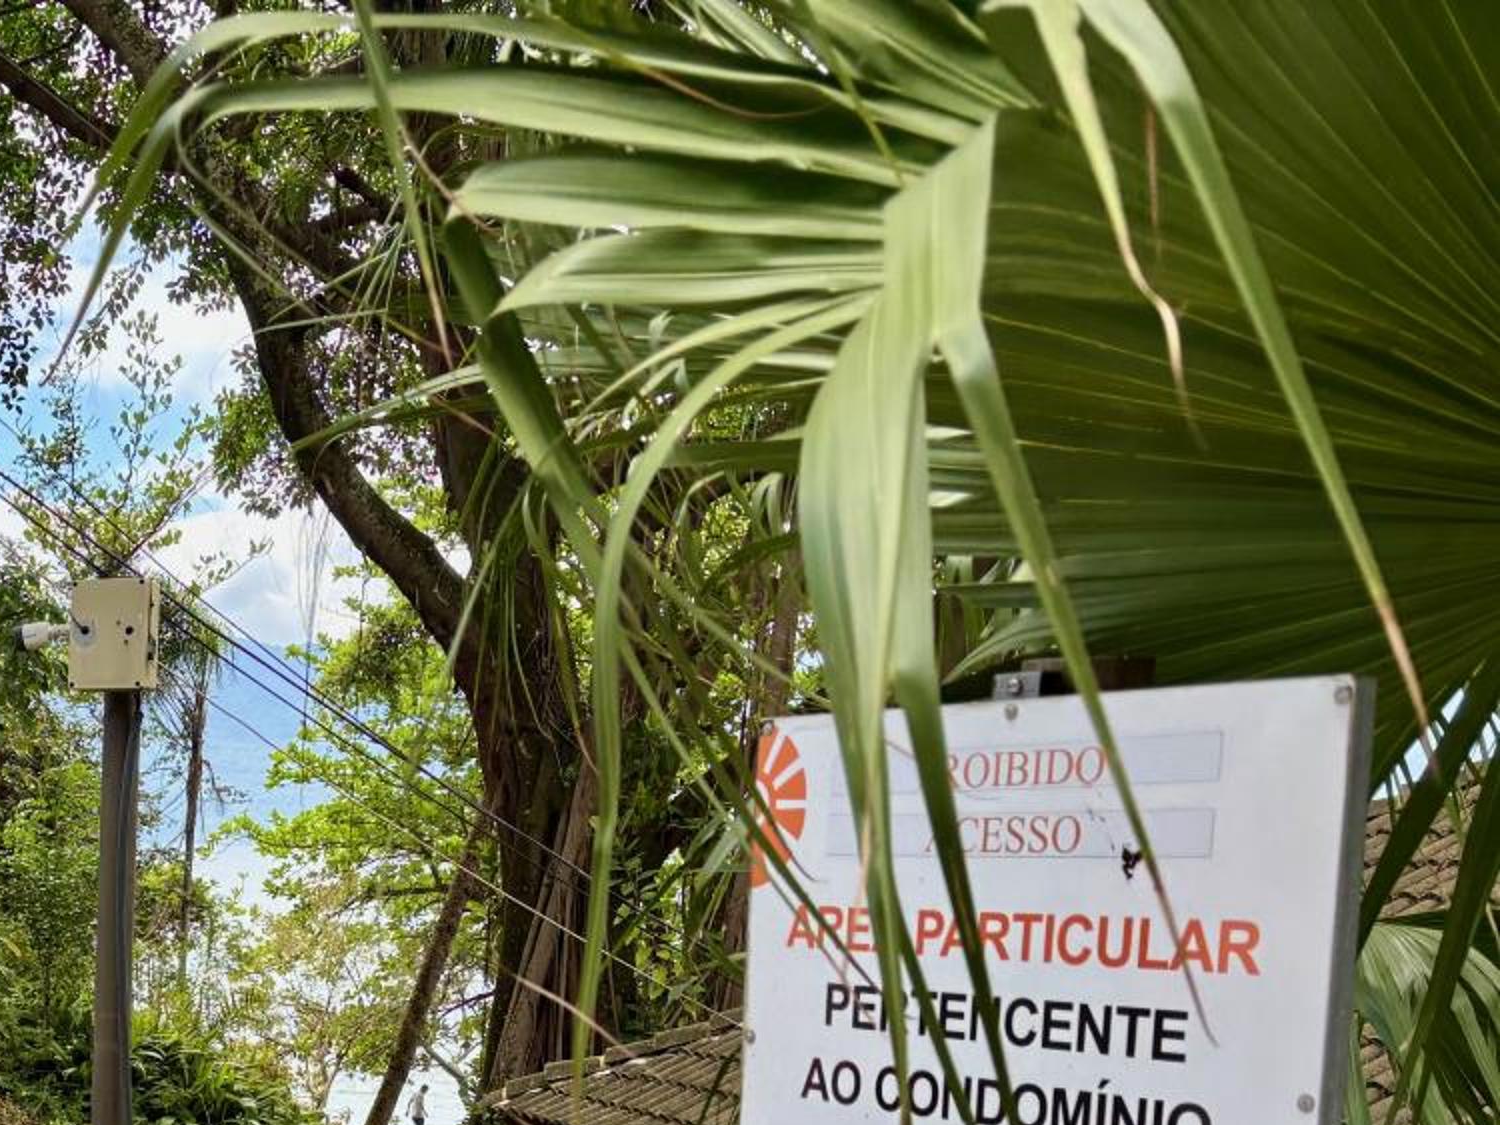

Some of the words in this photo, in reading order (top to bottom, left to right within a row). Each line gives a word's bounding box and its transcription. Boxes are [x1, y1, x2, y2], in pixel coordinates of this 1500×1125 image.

[947, 746, 1107, 789] ROIBIDO
[926, 815, 1081, 855] CESSO
[787, 903, 882, 953] ARE
[801, 1057, 861, 1105] AO
